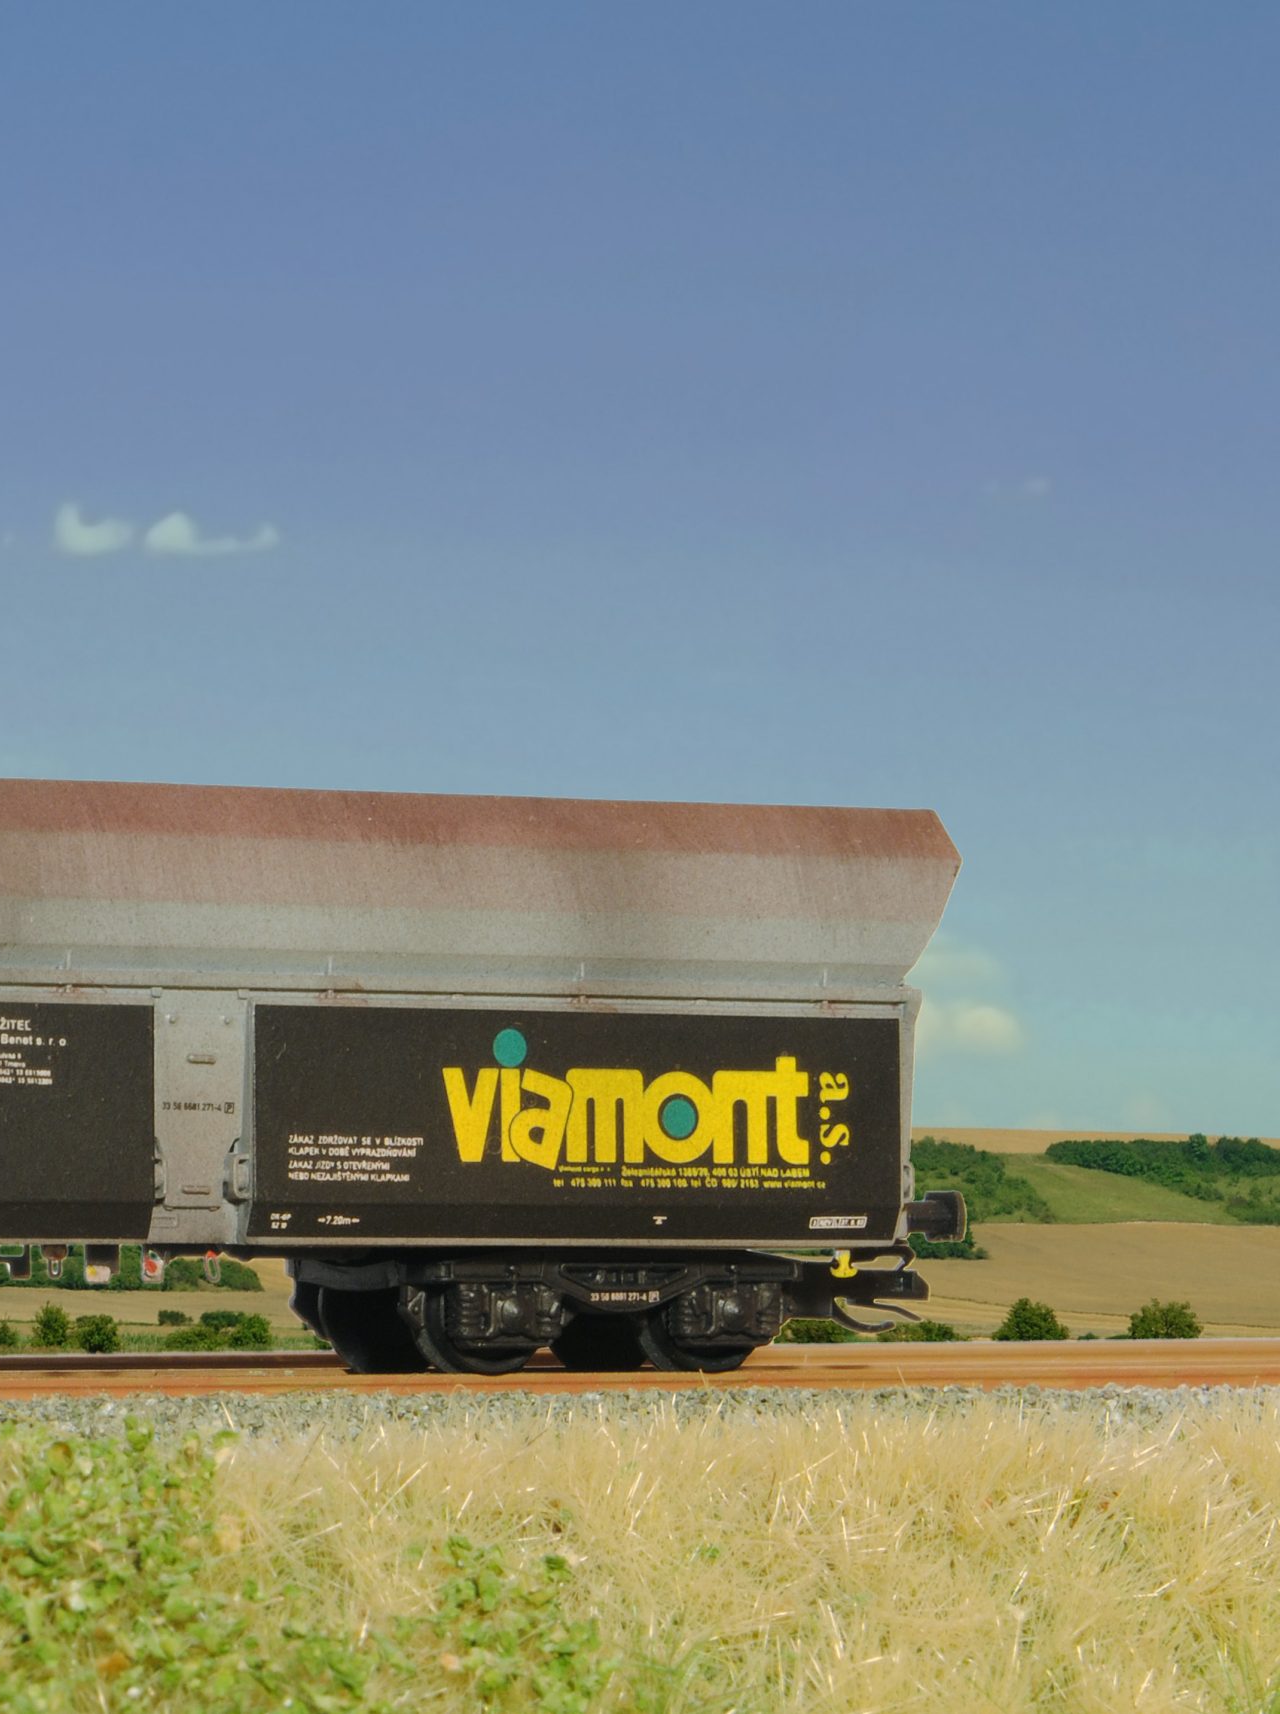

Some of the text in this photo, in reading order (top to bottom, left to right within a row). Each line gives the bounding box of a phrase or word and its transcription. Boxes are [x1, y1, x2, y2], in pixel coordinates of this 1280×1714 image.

[0, 1033, 33, 1046] Benet
[162, 1102, 171, 1110] 33
[173, 1102, 182, 1111] 56
[201, 1103, 222, 1112] 271-4
[819, 1072, 850, 1166] a.s.
[361, 1136, 372, 1145] SE
